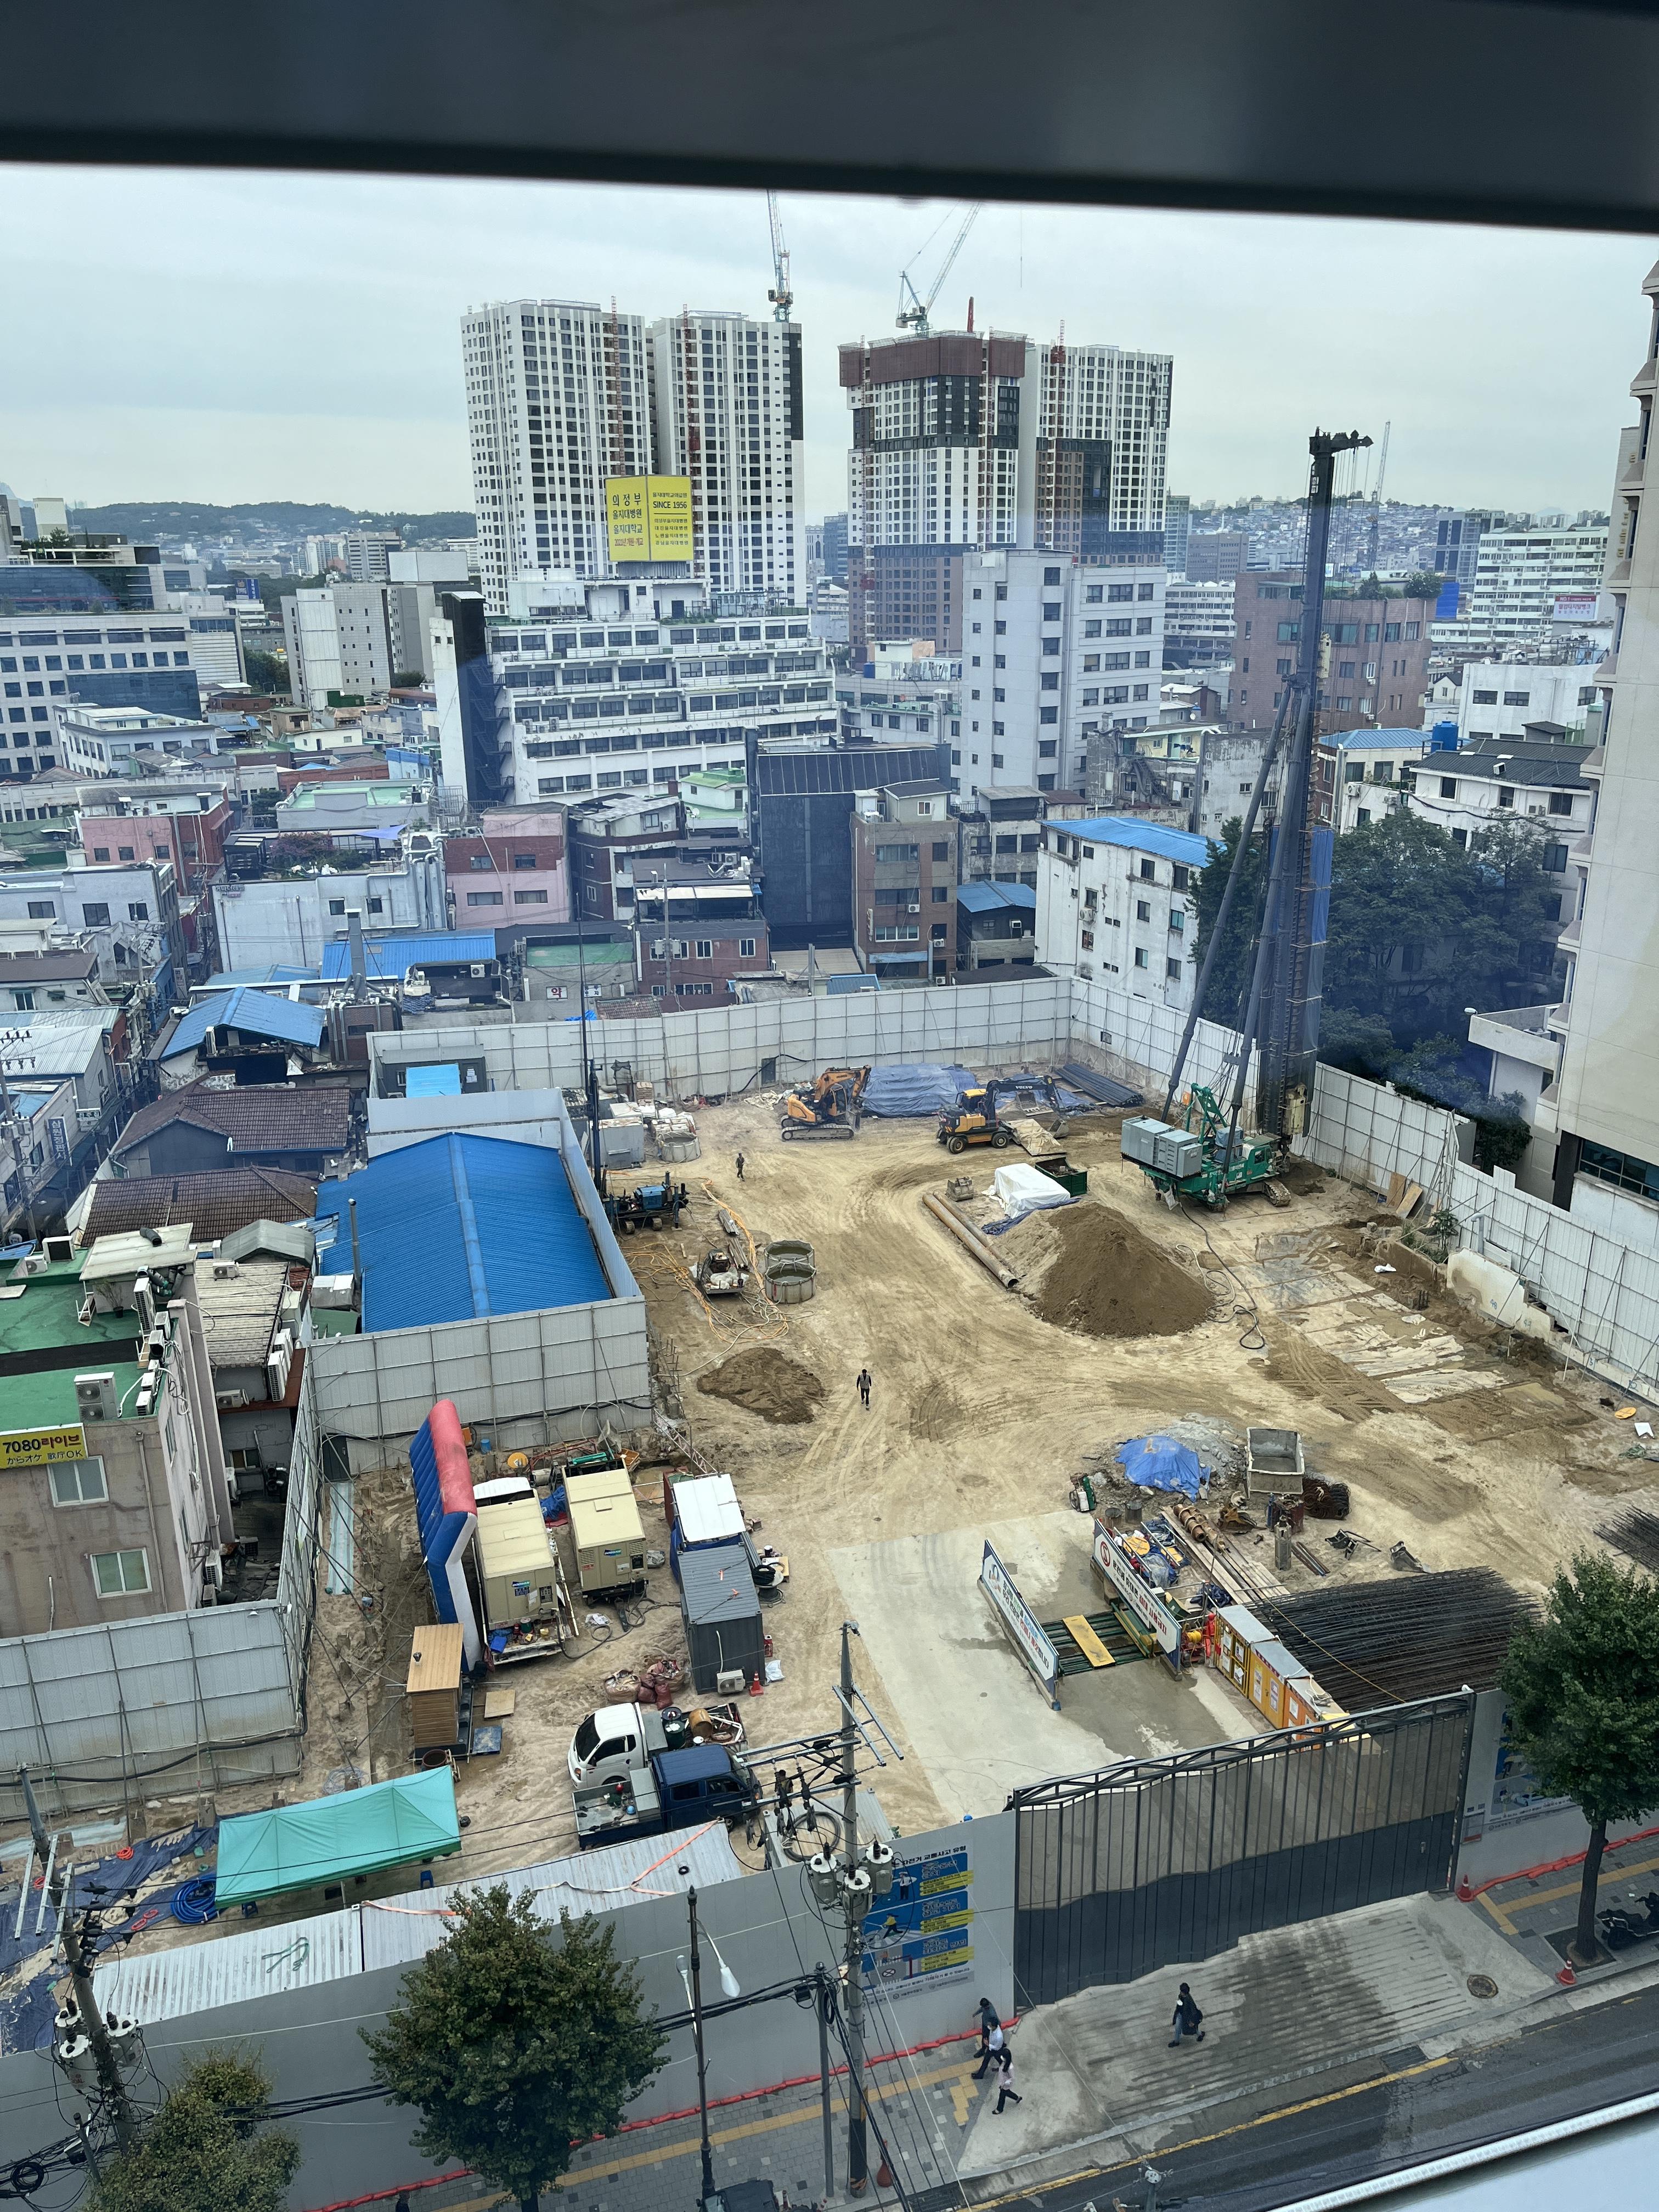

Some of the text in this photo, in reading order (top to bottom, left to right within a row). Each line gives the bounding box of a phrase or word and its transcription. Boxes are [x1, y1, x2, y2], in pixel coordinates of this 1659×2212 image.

[613, 509, 642, 520] 을지대병원
[614, 524, 643, 534] 을지대학교
[3, 1434, 81, 1454] 7080라이브
[7, 1454, 42, 1465] からオケ
[924, 1849, 951, 1860] 교통사고
